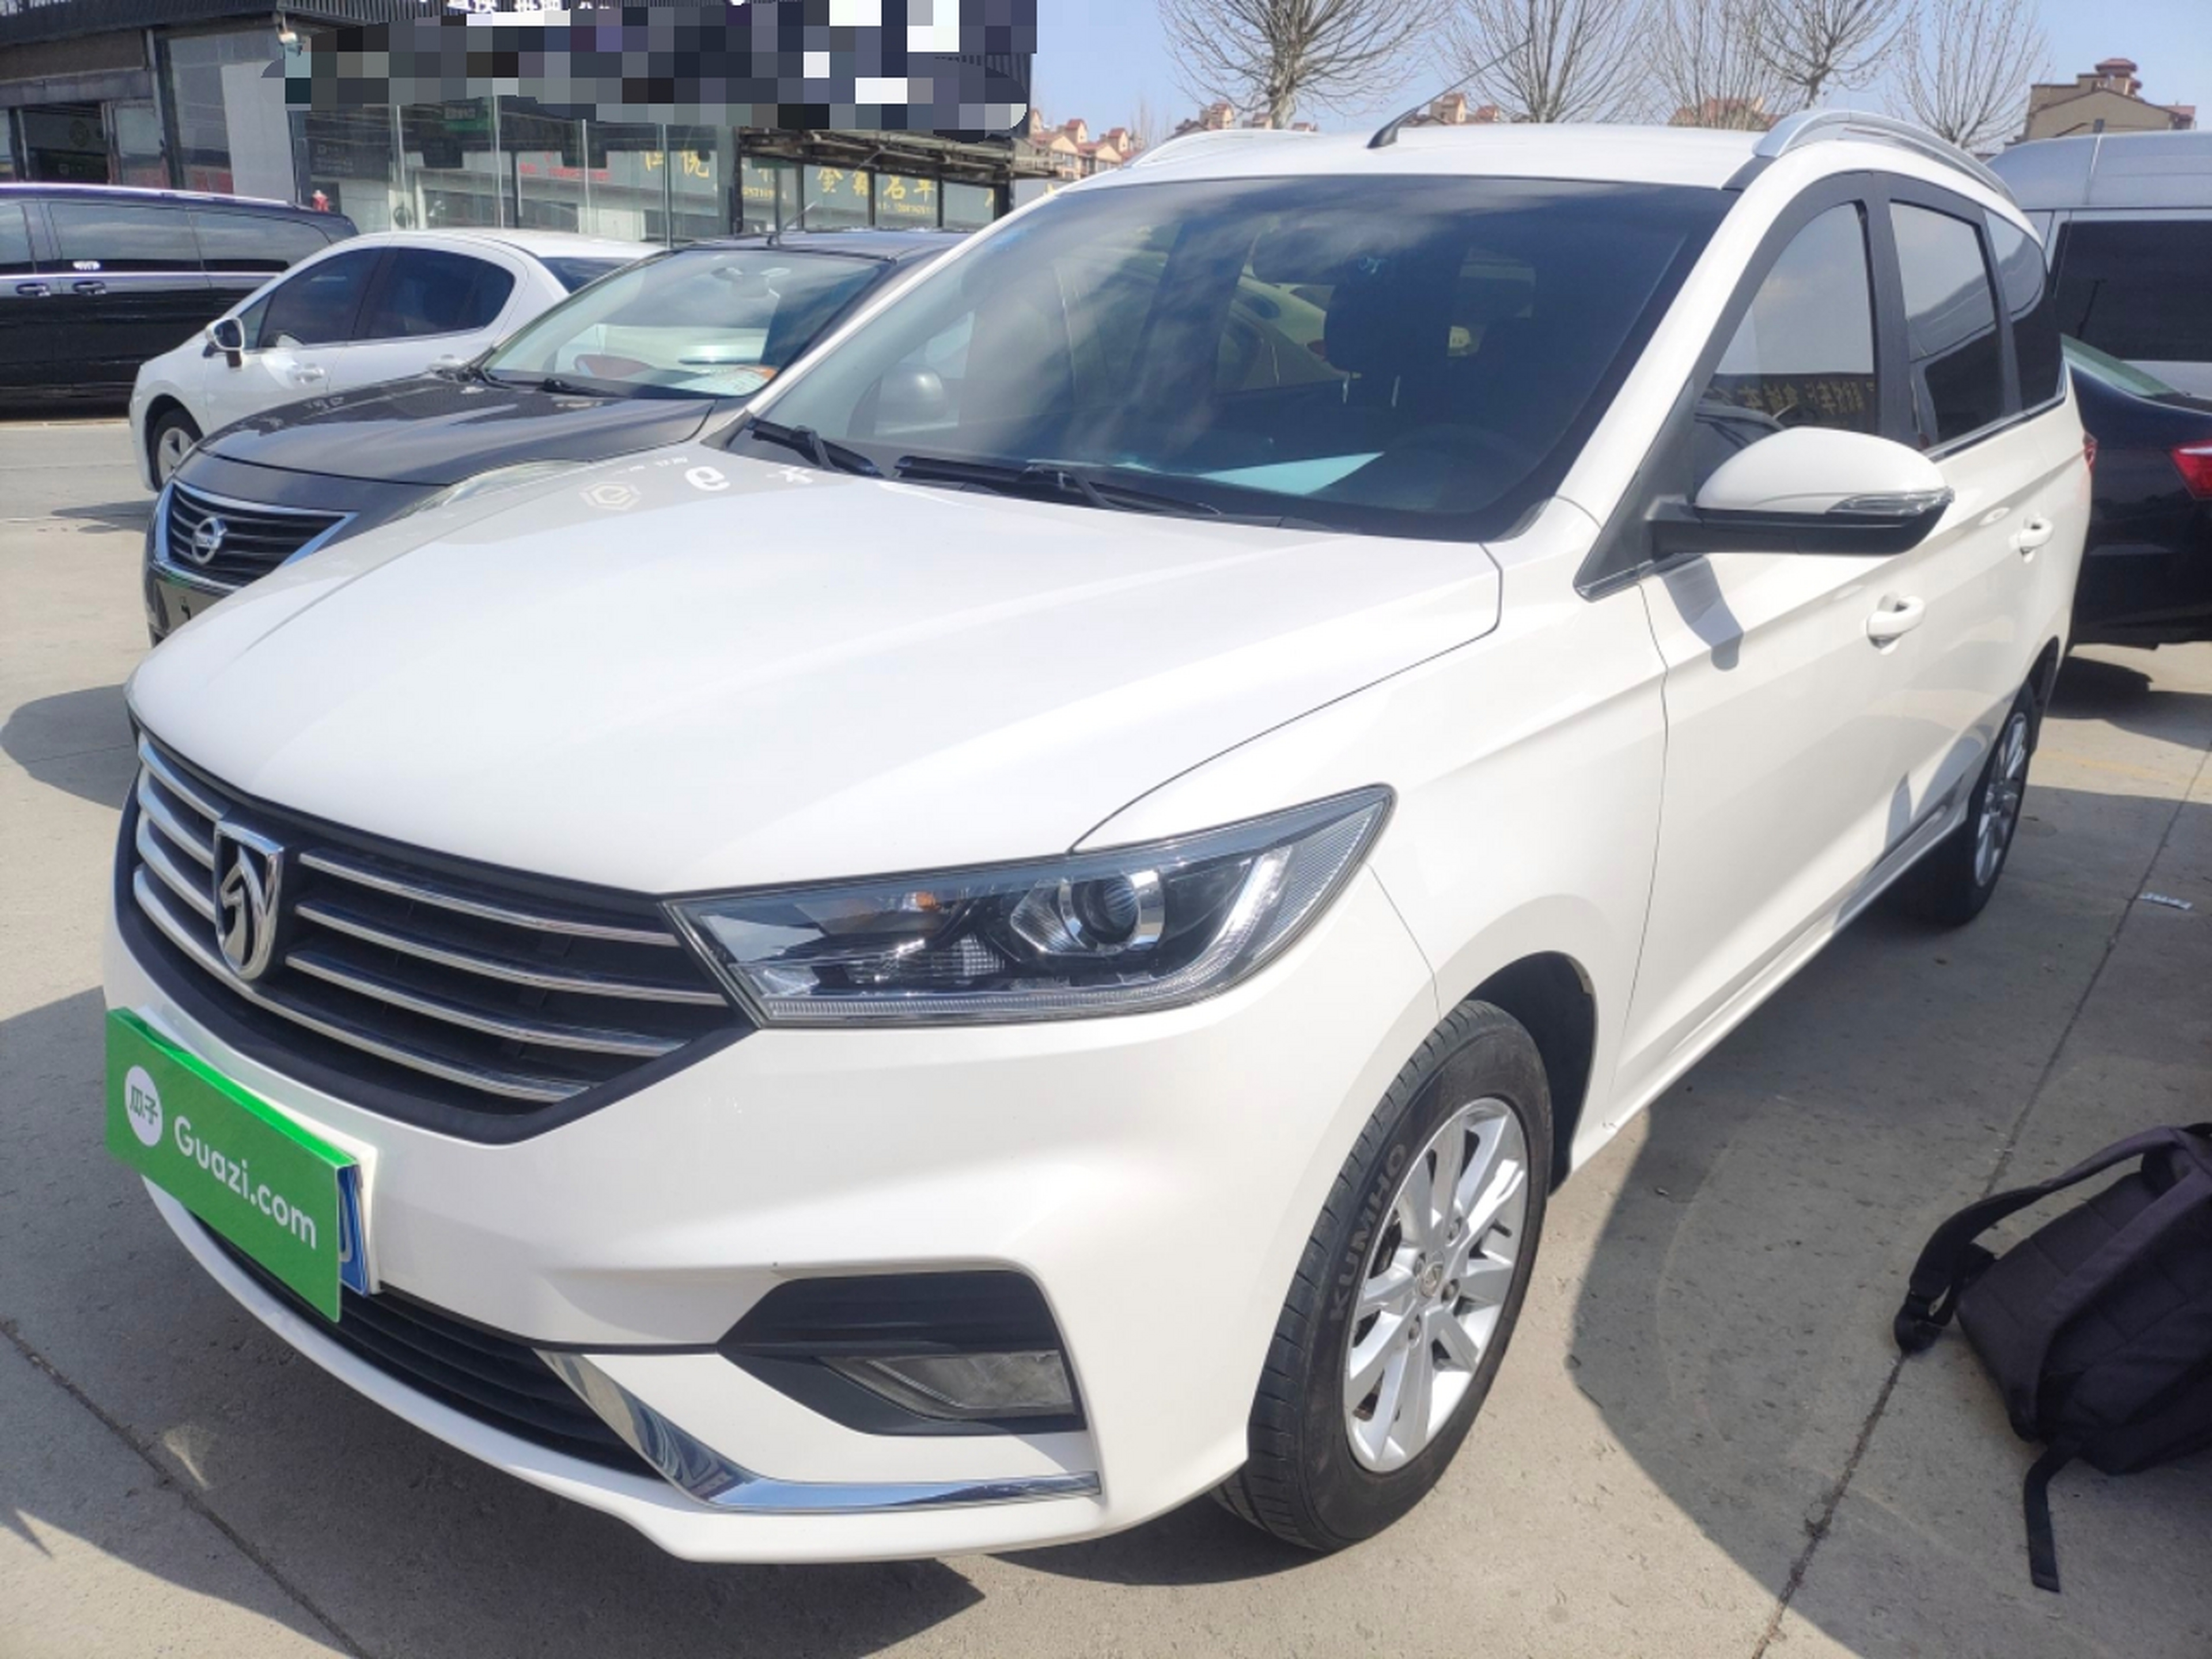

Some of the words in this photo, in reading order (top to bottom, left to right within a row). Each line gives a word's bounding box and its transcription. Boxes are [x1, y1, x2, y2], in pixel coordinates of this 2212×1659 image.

[129, 1085, 158, 1126] 瓜子
[174, 1116, 317, 1250] Guazi.com
[1330, 1143, 1407, 1321] KUMHO
